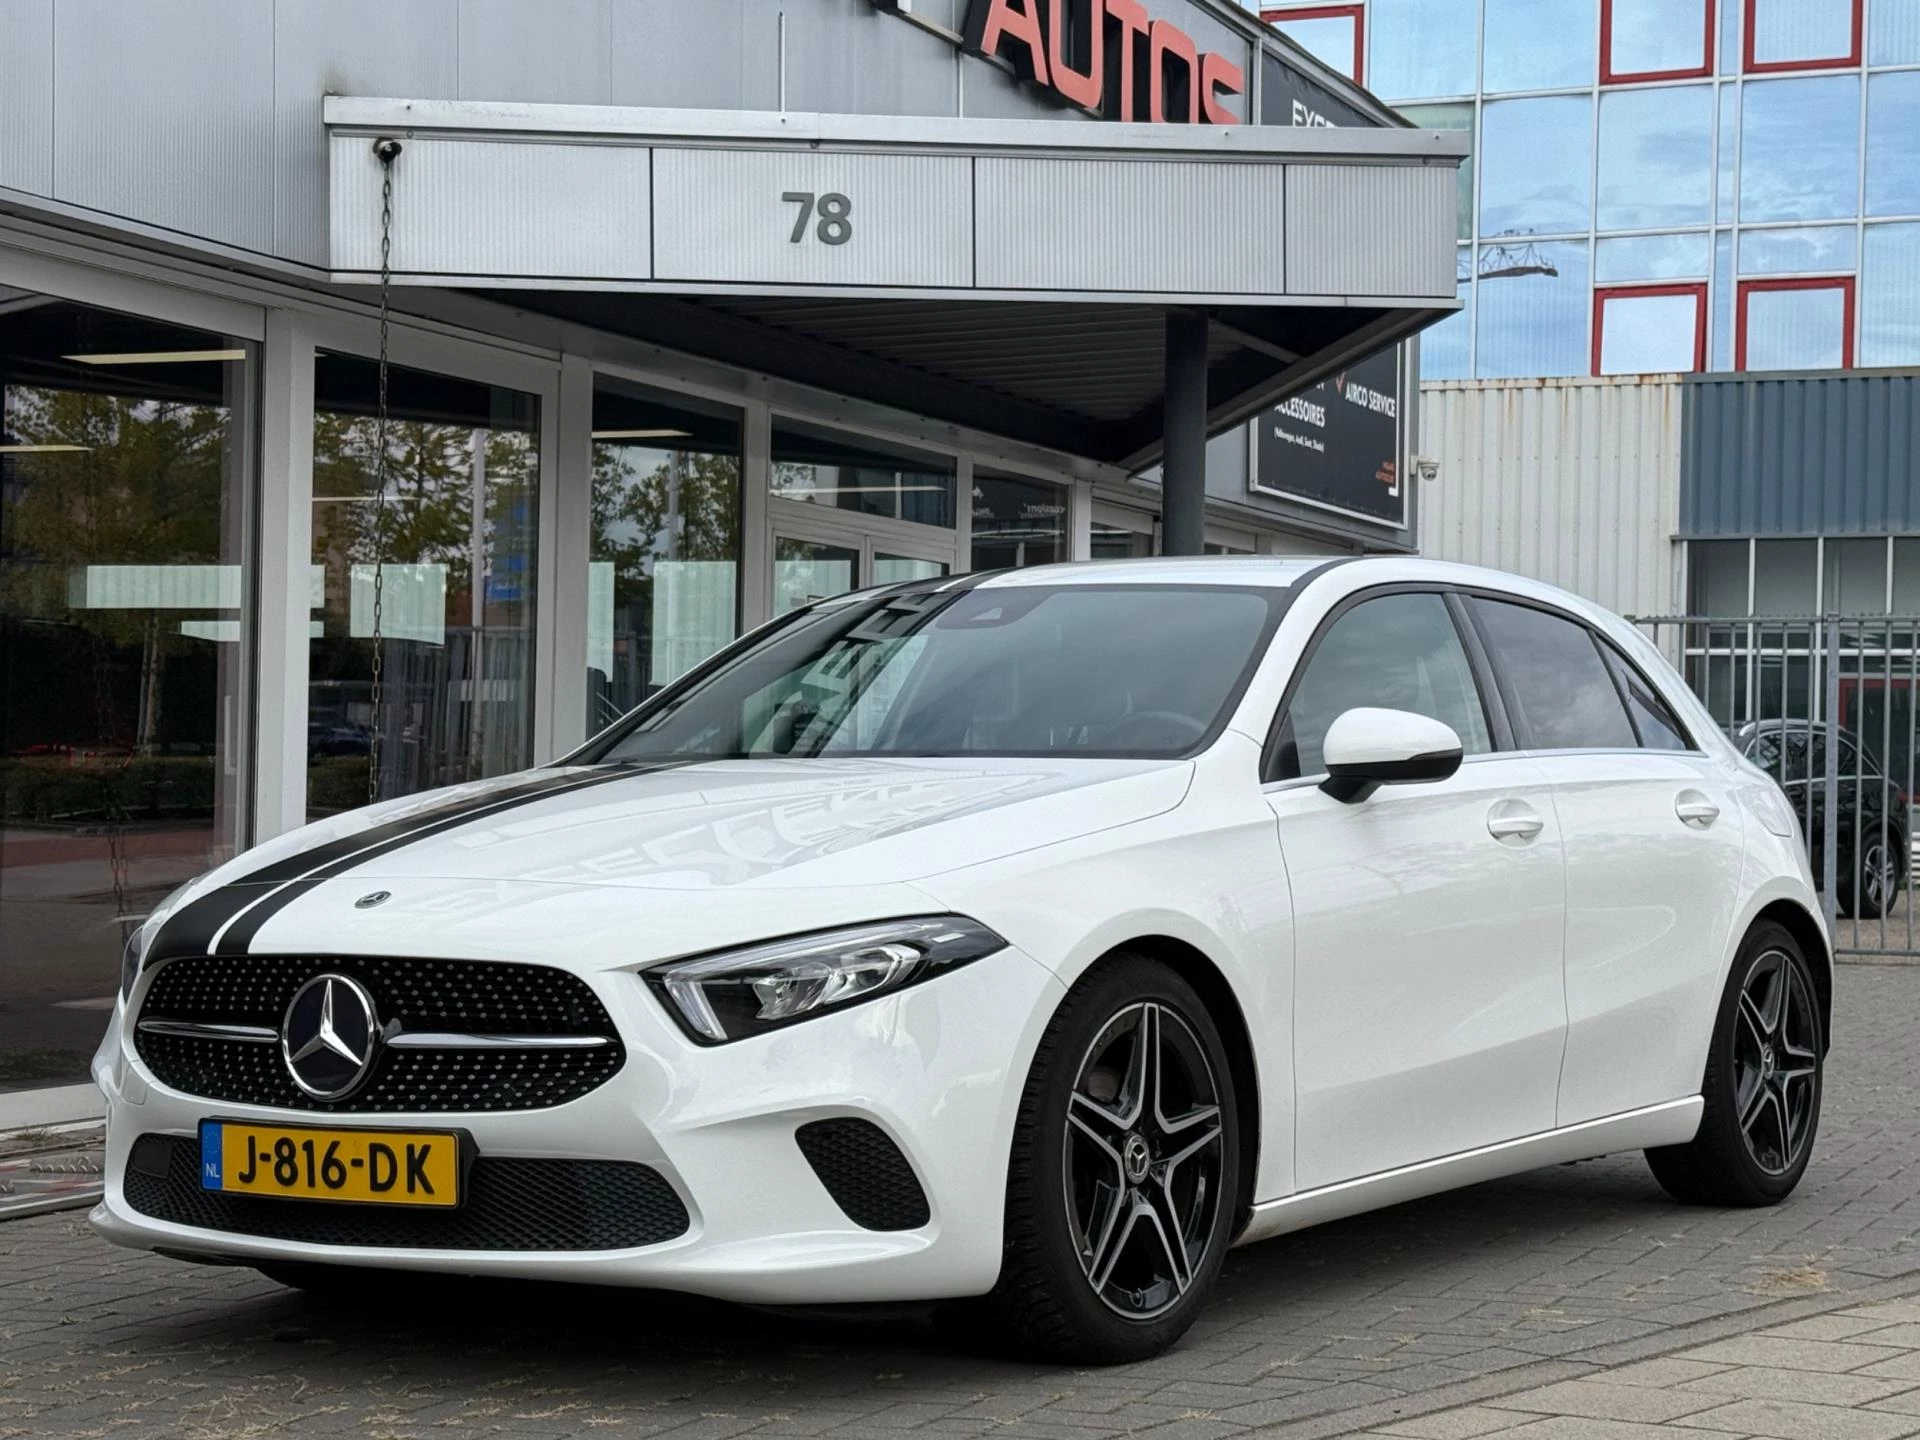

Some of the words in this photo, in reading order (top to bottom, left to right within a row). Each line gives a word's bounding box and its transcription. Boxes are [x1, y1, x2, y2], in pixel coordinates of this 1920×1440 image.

[781, 191, 852, 245] 78
[1345, 381, 1368, 407] AIRCO
[1369, 389, 1396, 418] SERVICE
[205, 1163, 220, 1179] NL
[238, 1135, 436, 1195] J-816-DK
